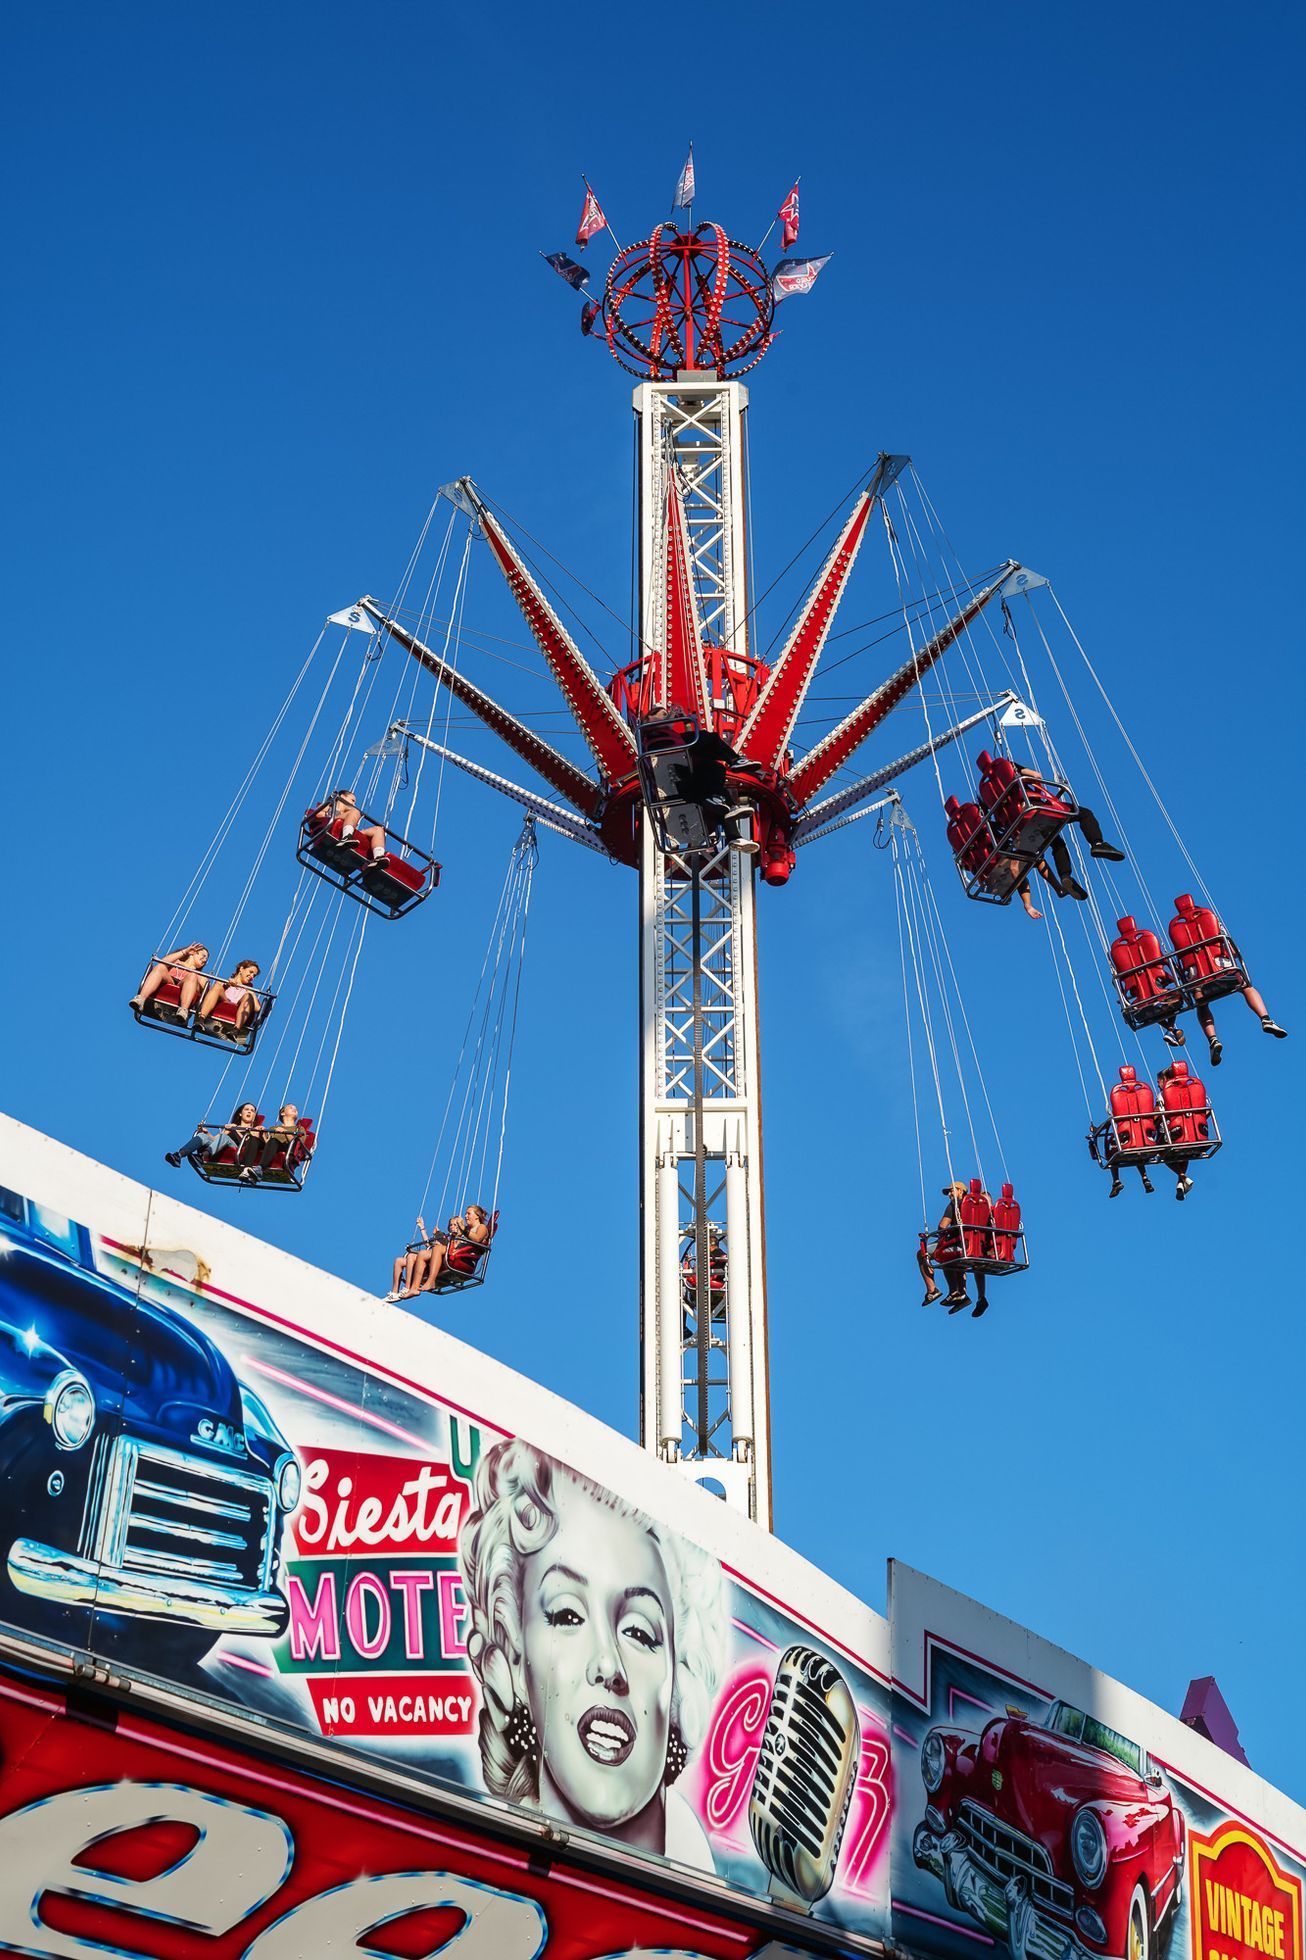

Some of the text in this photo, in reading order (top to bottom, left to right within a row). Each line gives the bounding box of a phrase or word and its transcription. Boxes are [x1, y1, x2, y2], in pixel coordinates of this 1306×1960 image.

[348, 611, 361, 623] S
[299, 1458, 463, 1551] Siesta
[322, 1695, 473, 1724] NO VACANCY
[1205, 1878, 1285, 1960] VINTAGE
